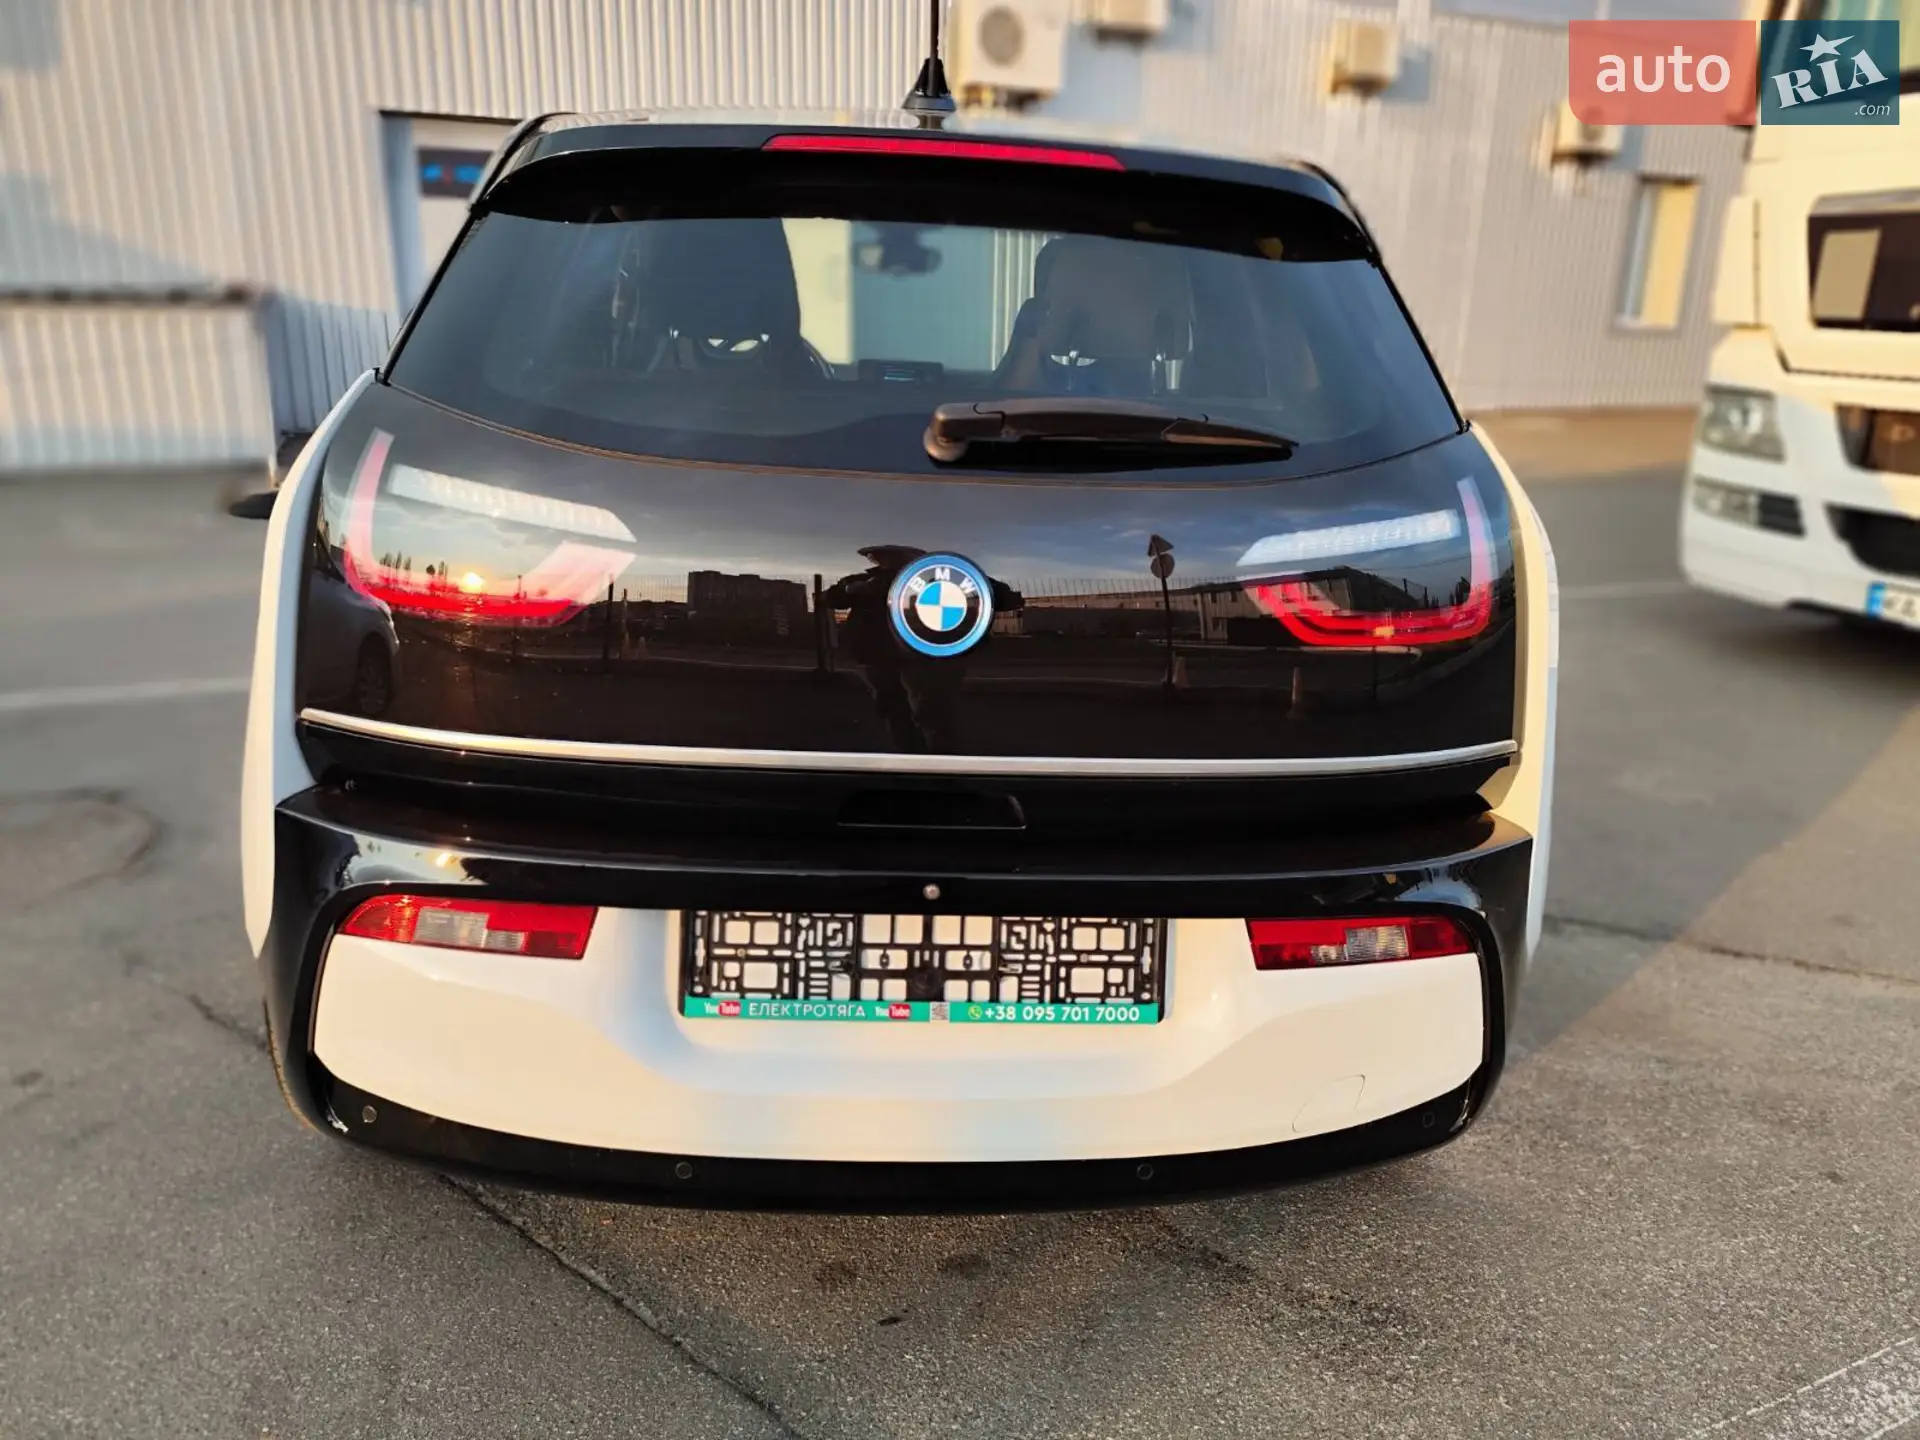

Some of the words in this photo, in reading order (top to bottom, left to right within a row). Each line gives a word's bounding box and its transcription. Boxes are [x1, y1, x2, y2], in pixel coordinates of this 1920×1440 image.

[908, 567, 976, 593] BMW
[748, 1002, 866, 1017] ЕЛЕКТРОТЯГА
[985, 1007, 1016, 1020] +38
[1022, 1008, 1056, 1021] 095
[1062, 1008, 1090, 1021] 701
[1095, 1009, 1140, 1022] 7000
